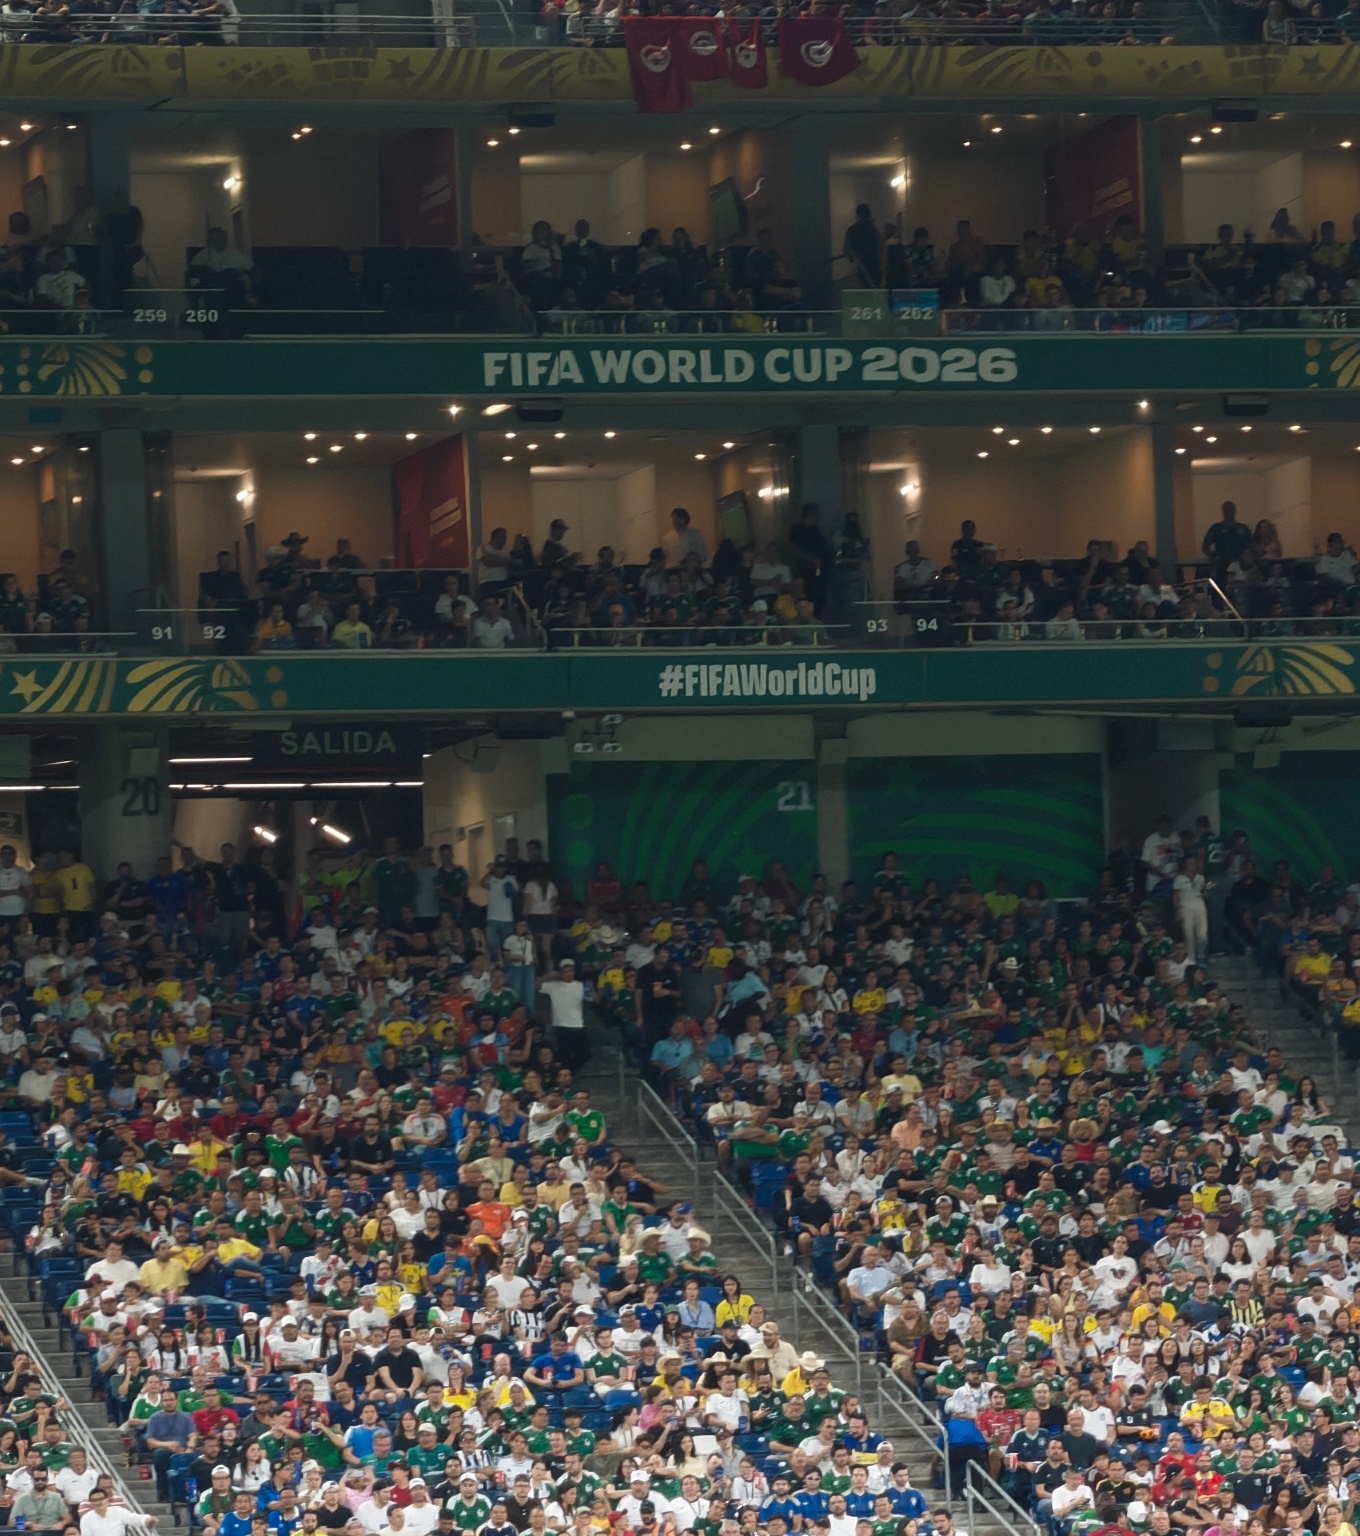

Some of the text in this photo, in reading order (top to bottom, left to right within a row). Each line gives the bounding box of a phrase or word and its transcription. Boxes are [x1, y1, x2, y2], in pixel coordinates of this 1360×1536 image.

[133, 308, 167, 323] 259
[185, 309, 219, 323] 260
[483, 346, 1018, 387] FIFA WORLD CUP 2026
[866, 618, 889, 633] 93
[916, 617, 938, 632] 94
[151, 626, 173, 640] 91
[202, 625, 226, 640] 92
[658, 661, 877, 702] #FIFAWorldCup
[280, 730, 397, 758] SALIDA
[120, 777, 161, 817] 20
[776, 780, 816, 812] 21
